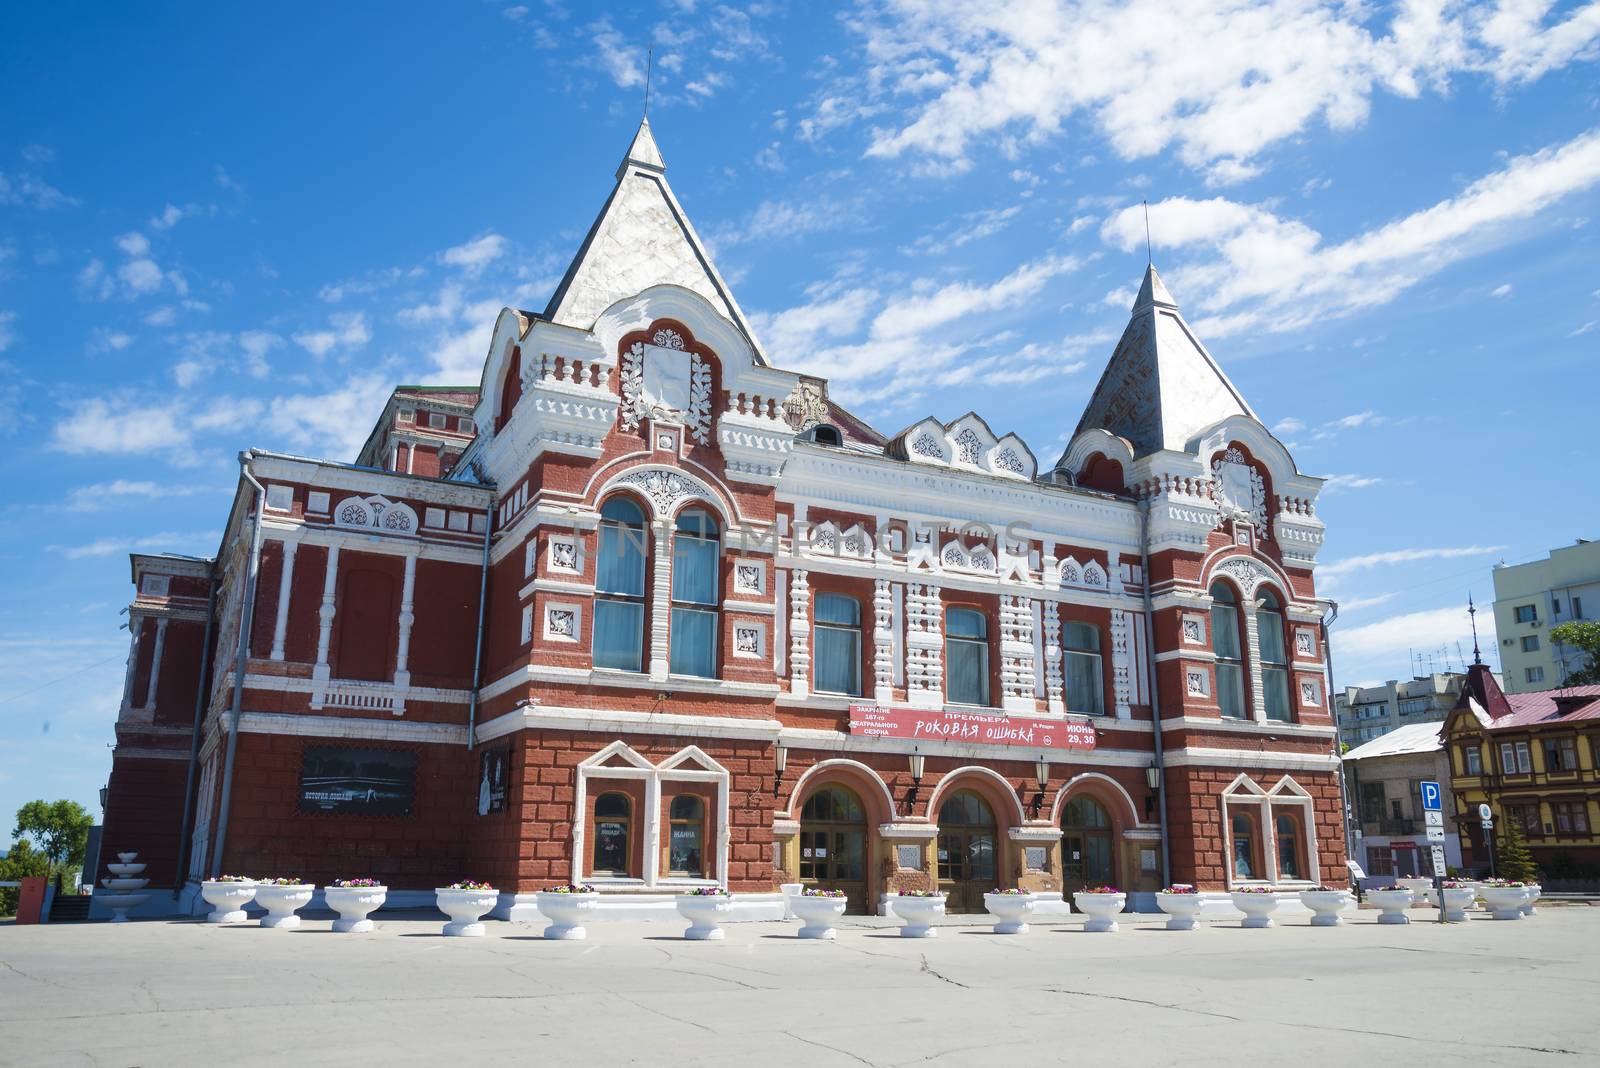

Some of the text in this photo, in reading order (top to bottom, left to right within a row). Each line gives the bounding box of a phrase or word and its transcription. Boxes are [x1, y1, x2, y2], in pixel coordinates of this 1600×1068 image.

[945, 713, 1010, 724] ПРЕМЬЕРА
[864, 728, 889, 736] СЕЗОНА
[914, 718, 980, 738] РОКОВАЯ
[986, 726, 1035, 743] ОШИБКА
[1066, 724, 1094, 734] ИЮНЬ
[1068, 734, 1095, 745] 29, 30
